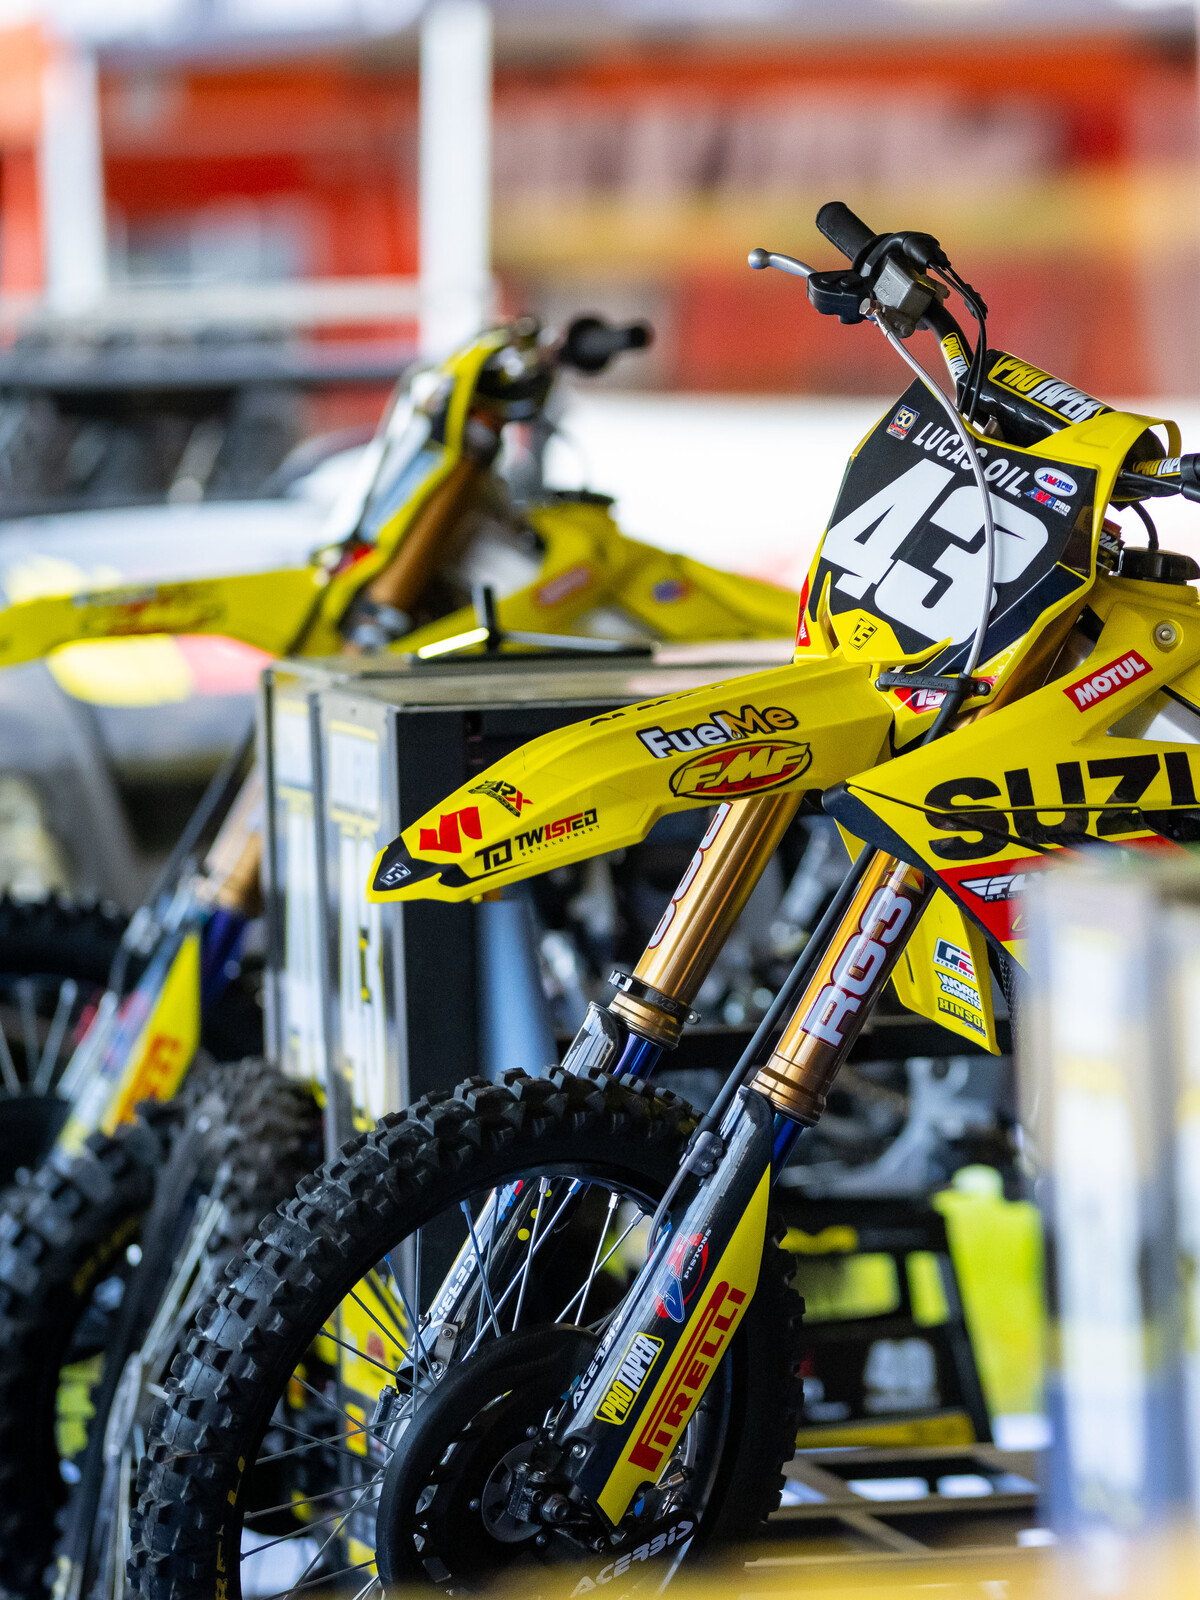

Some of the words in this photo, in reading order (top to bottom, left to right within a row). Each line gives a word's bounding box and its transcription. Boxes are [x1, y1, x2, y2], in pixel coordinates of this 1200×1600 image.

[820, 458, 1049, 645] 43
[1074, 656, 1146, 706] MOTUL
[636, 705, 798, 758] FuelMe
[674, 743, 810, 797] FMF
[522, 825, 600, 856] DEVELOPMENT
[800, 884, 913, 1047] RG3
[683, 1229, 712, 1280] PISTONS
[628, 1281, 747, 1472] PIRELLI
